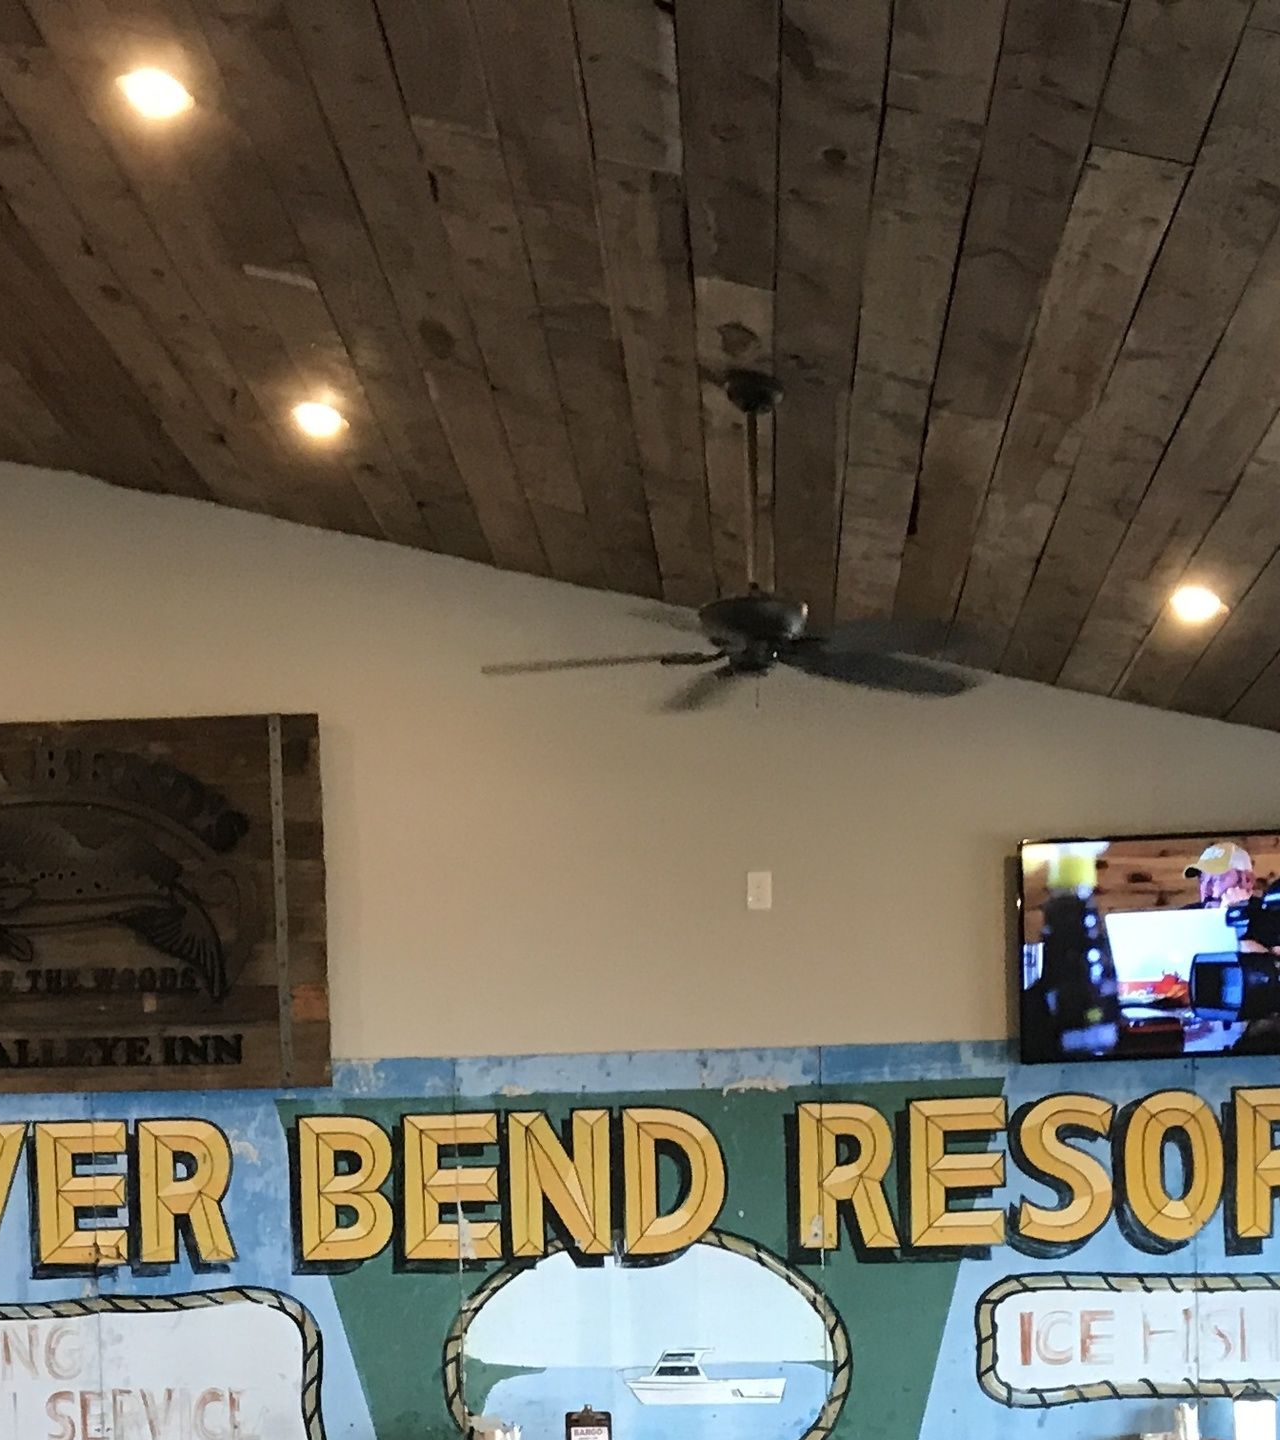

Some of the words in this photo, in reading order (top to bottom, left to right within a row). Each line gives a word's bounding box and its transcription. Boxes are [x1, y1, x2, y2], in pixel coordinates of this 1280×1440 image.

[162, 1033, 245, 1066] INN
[288, 1103, 727, 1274] BEND
[1018, 1309, 1115, 1367] ICE
